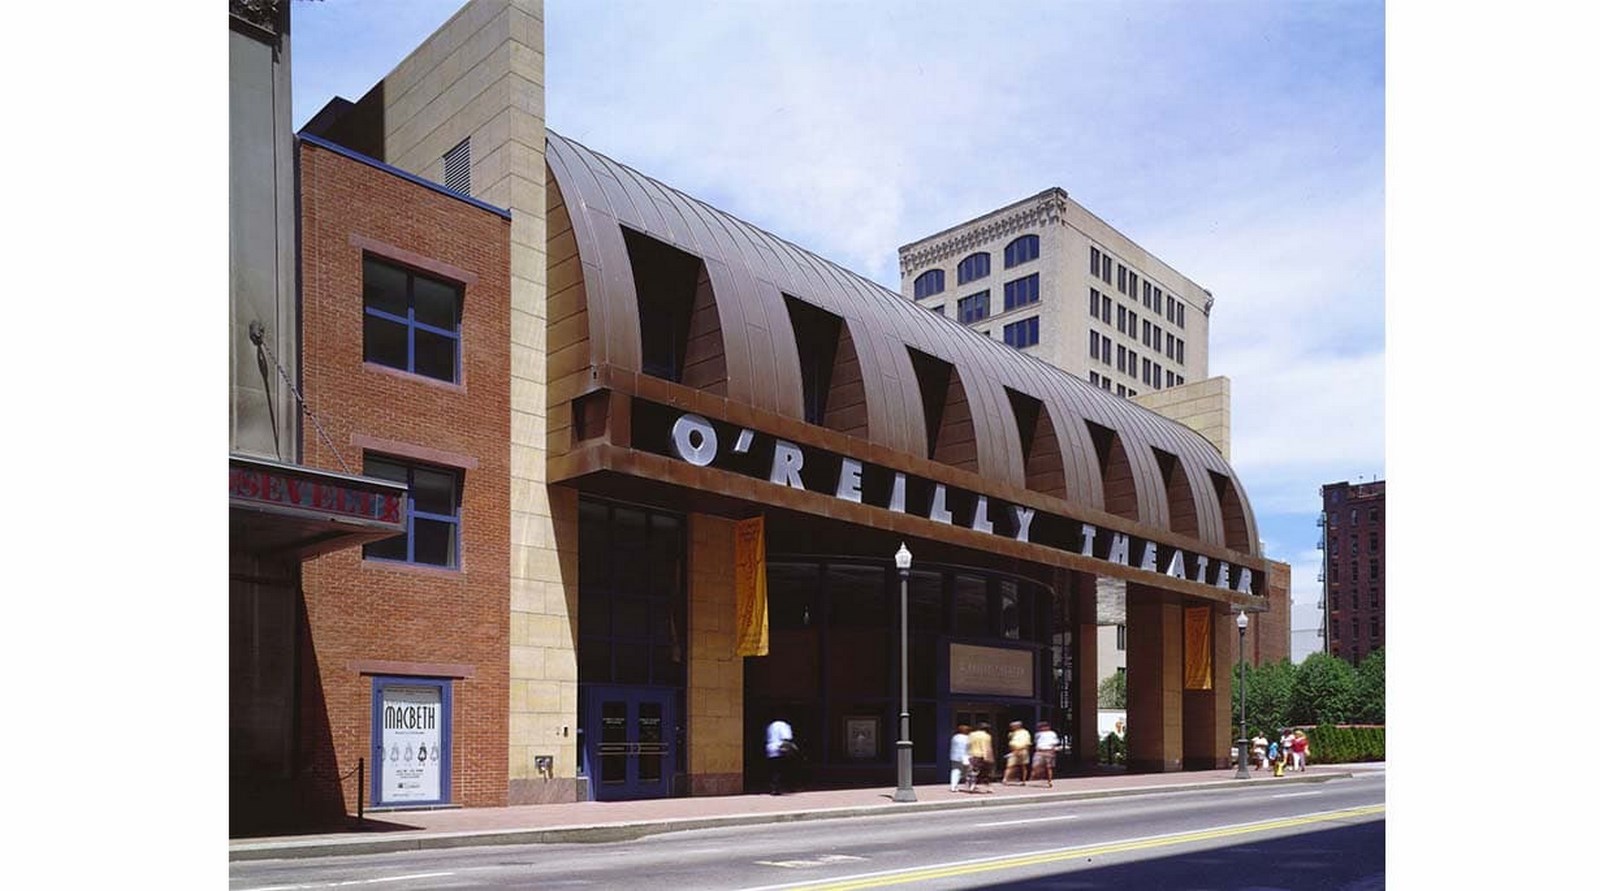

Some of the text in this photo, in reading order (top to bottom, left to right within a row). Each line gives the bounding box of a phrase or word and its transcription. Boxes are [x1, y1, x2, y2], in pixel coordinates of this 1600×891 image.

[672, 413, 1253, 595] O'REILLY THEATER
[385, 705, 435, 729] MACBETH
